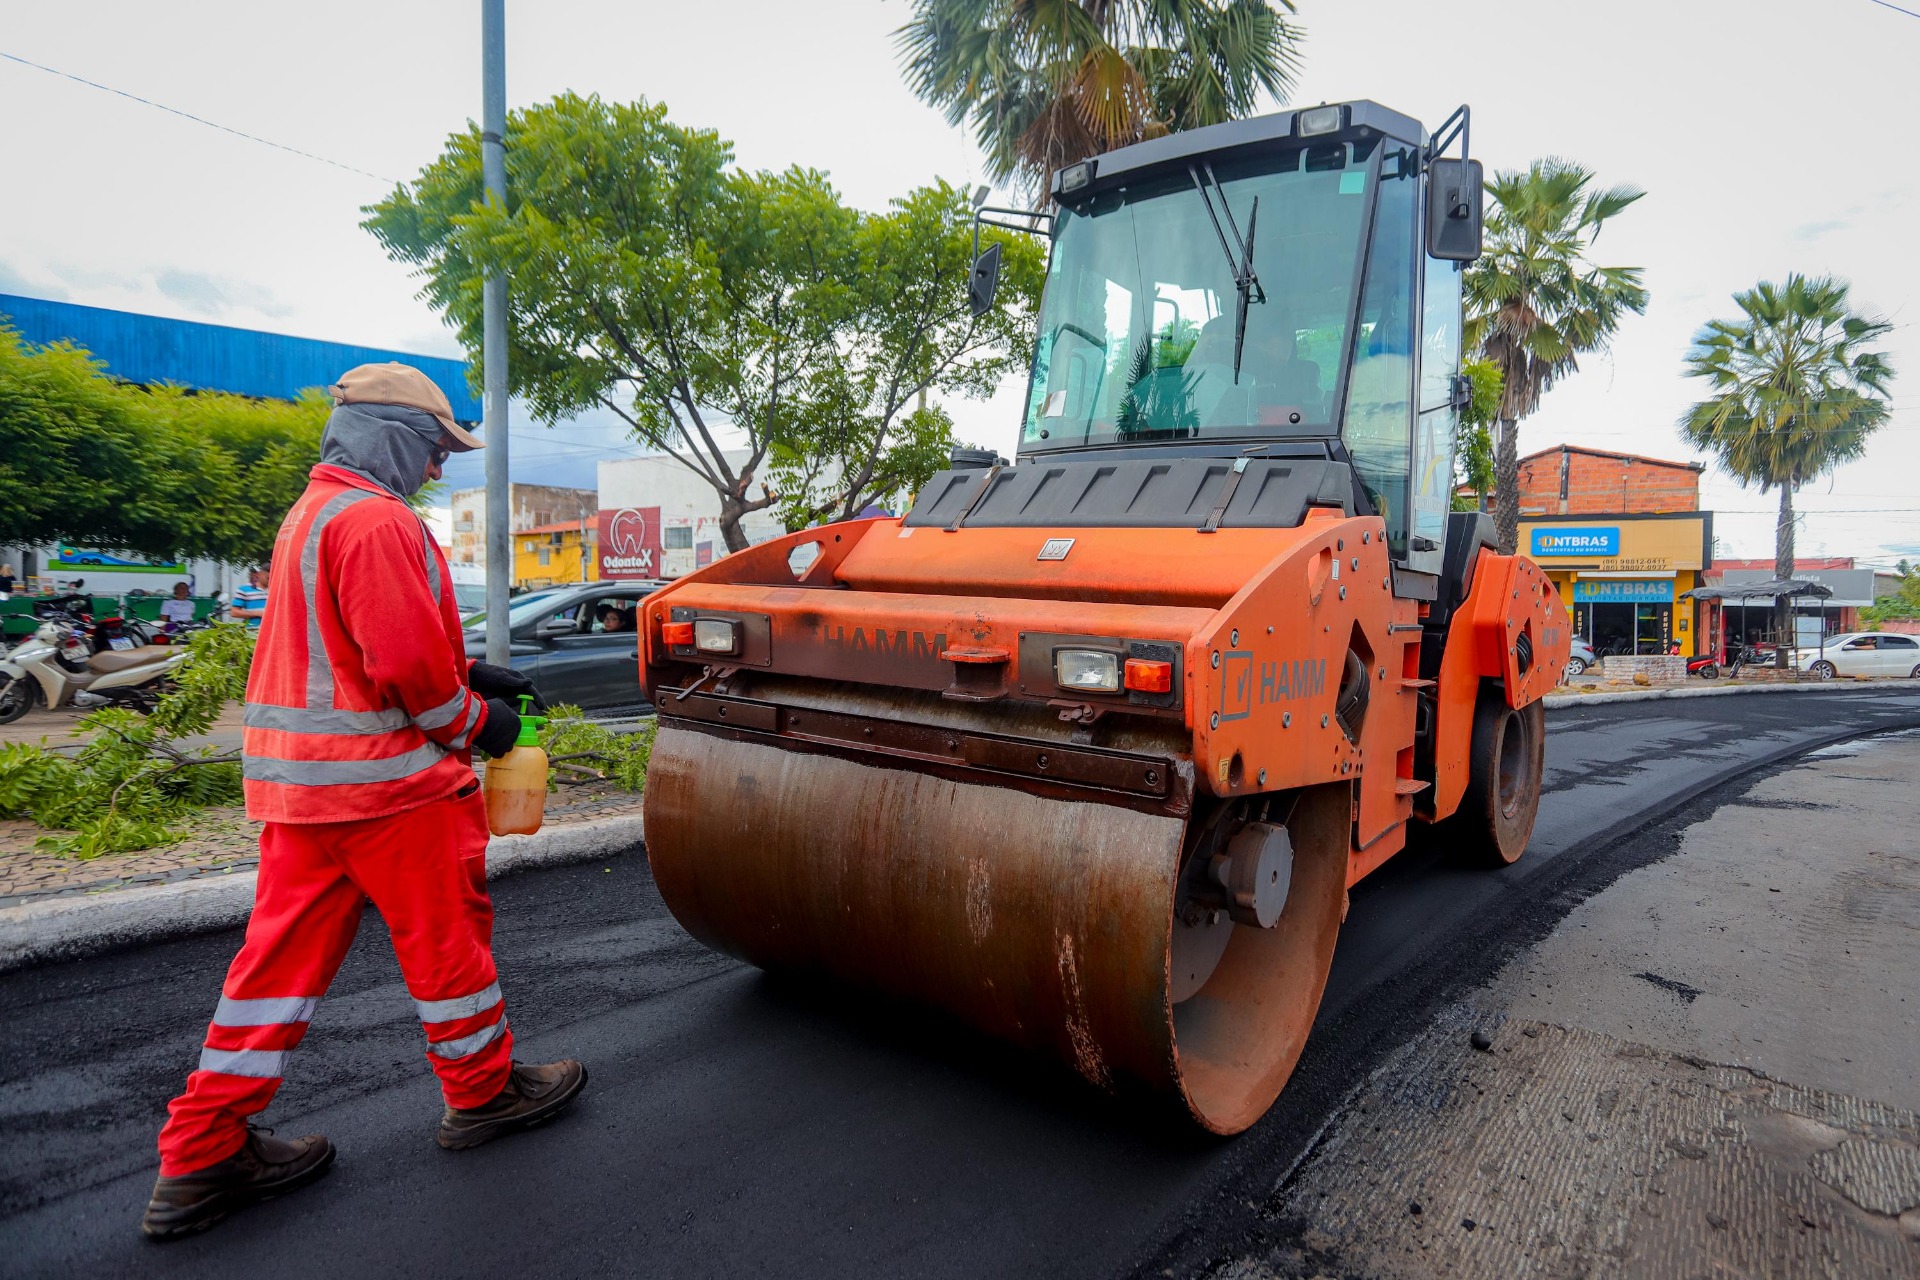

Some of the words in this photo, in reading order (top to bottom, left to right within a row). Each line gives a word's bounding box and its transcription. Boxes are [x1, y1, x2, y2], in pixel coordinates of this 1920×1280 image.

[603, 548, 653, 568] OdontoX
[823, 625, 947, 664] HAMM
[1259, 658, 1326, 704] HAMM
